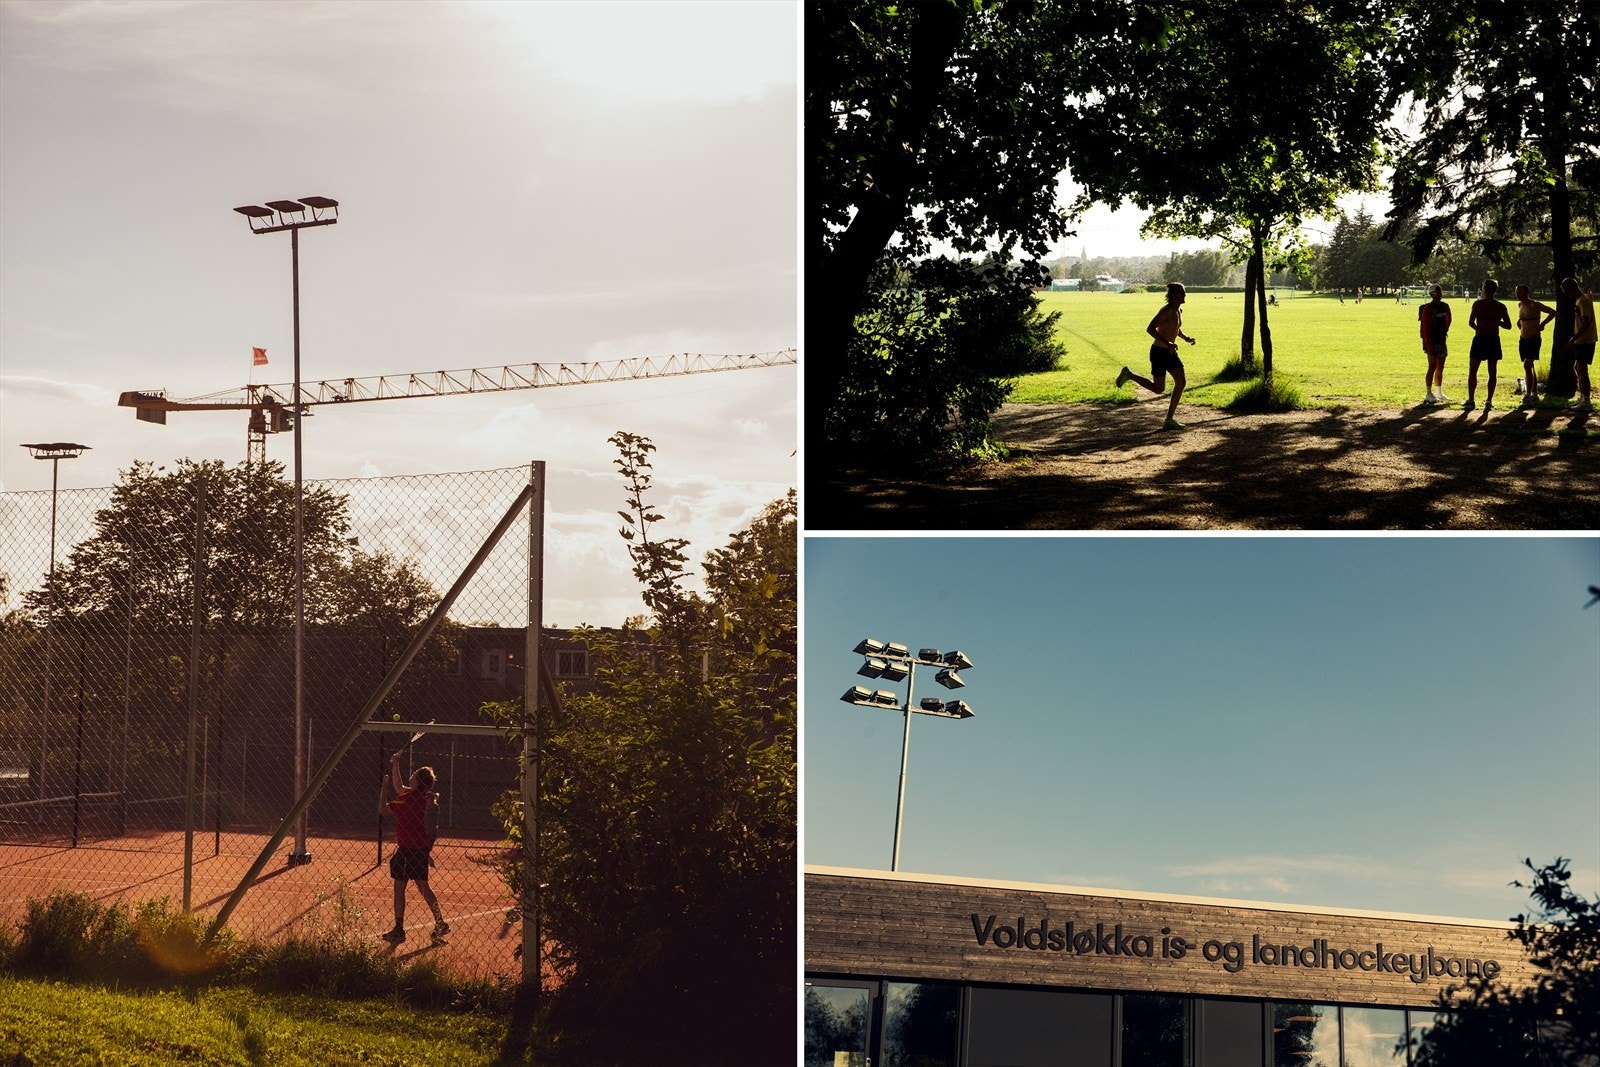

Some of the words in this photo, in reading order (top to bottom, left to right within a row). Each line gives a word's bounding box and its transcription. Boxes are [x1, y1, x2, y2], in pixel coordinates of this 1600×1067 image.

[971, 913, 1154, 958] Voldsløkka
[1161, 926, 1197, 959] is-
[1202, 939, 1245, 973] og
[1252, 934, 1501, 984] landhockeybane
